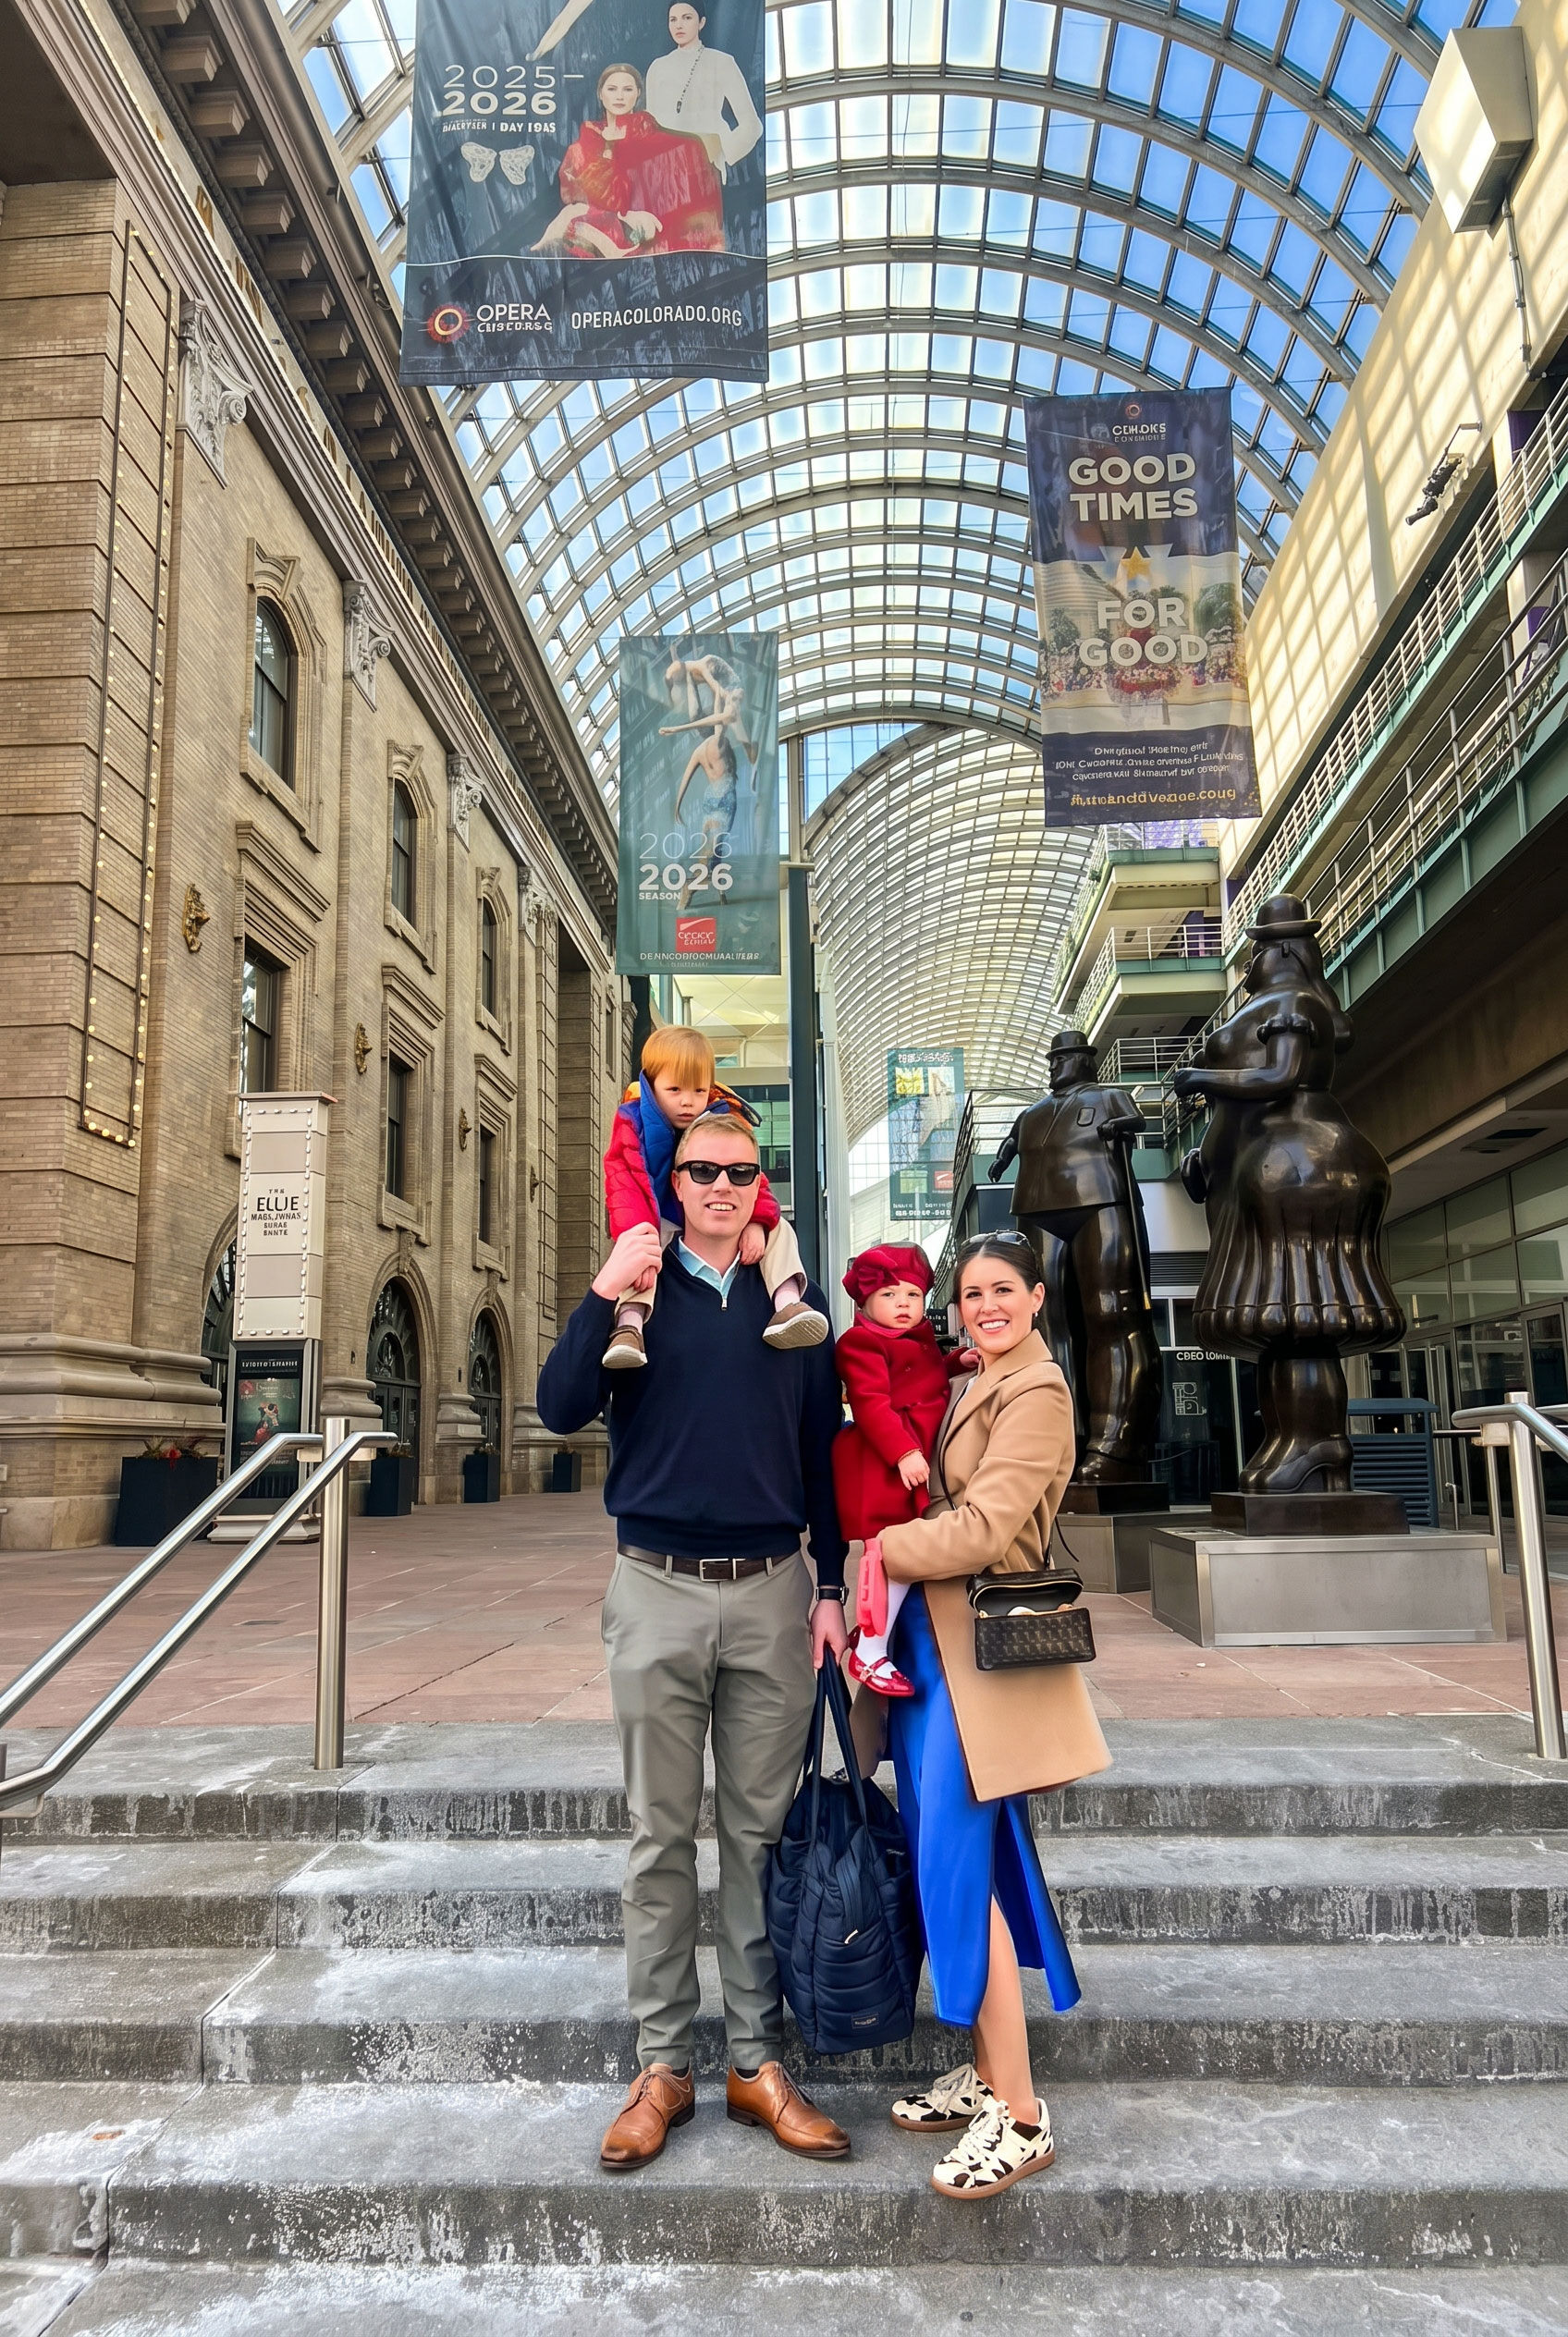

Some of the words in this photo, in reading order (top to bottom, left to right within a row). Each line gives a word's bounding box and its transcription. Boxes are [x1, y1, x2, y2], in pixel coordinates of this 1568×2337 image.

[442, 91, 557, 116] 2026
[500, 122, 524, 132] DAY
[476, 303, 552, 323] OPERA
[571, 305, 742, 330] OPERACOLORADO.ORG
[1068, 452, 1196, 486] GOOD
[1069, 487, 1198, 521] TIMES
[1096, 596, 1187, 630] FOR
[1079, 634, 1208, 667] GOOD
[639, 863, 734, 891] 2026
[639, 892, 681, 900] SEASON
